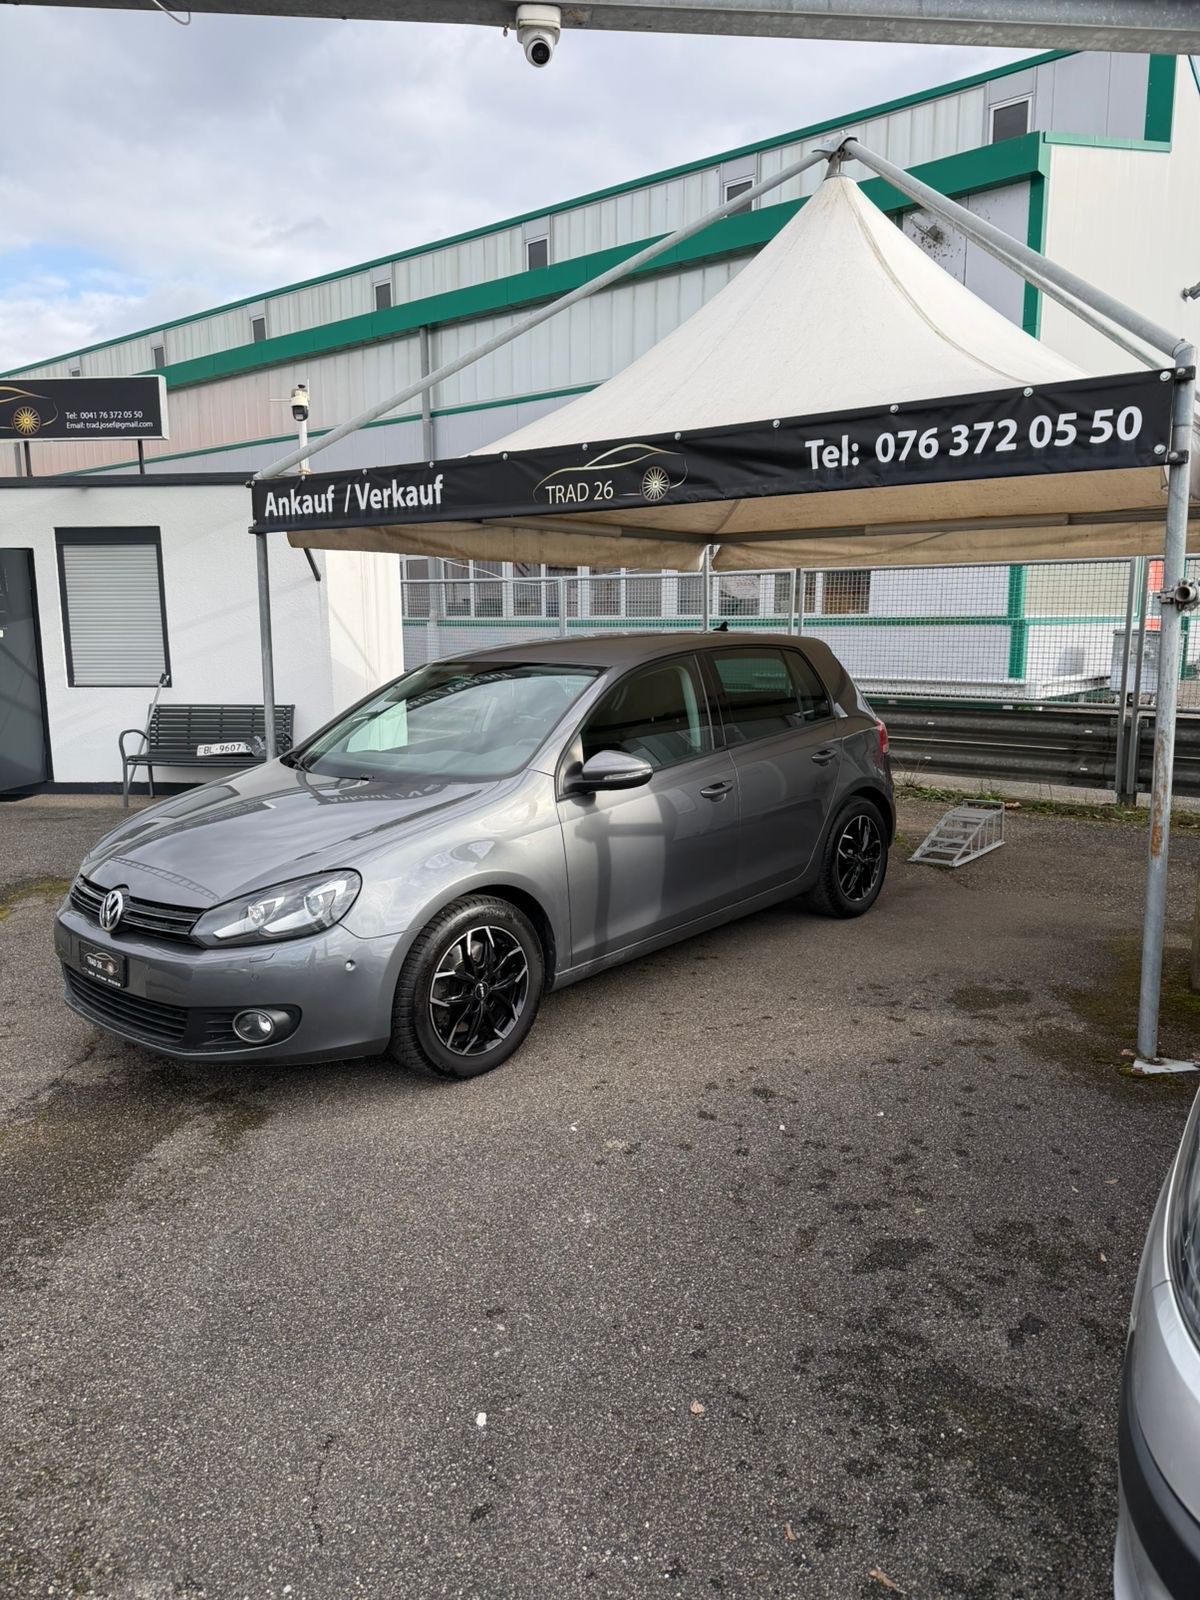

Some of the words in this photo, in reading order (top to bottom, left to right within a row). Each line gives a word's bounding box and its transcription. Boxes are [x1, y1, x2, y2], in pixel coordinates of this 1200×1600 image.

[65, 411, 78, 420] Tel:
[80, 411, 97, 420] 0041
[99, 411, 108, 419] 76
[109, 411, 122, 419] 372
[123, 410, 132, 419] 05
[133, 410, 143, 418] 50
[66, 421, 85, 430] Email:
[805, 434, 859, 470] Tel:
[875, 427, 940, 463] 076
[948, 418, 1018, 456] 372
[1028, 412, 1078, 449] 05
[1089, 406, 1143, 444] 50
[264, 484, 335, 517] Ankauf
[545, 482, 589, 505] TRAD
[593, 480, 614, 500] 26
